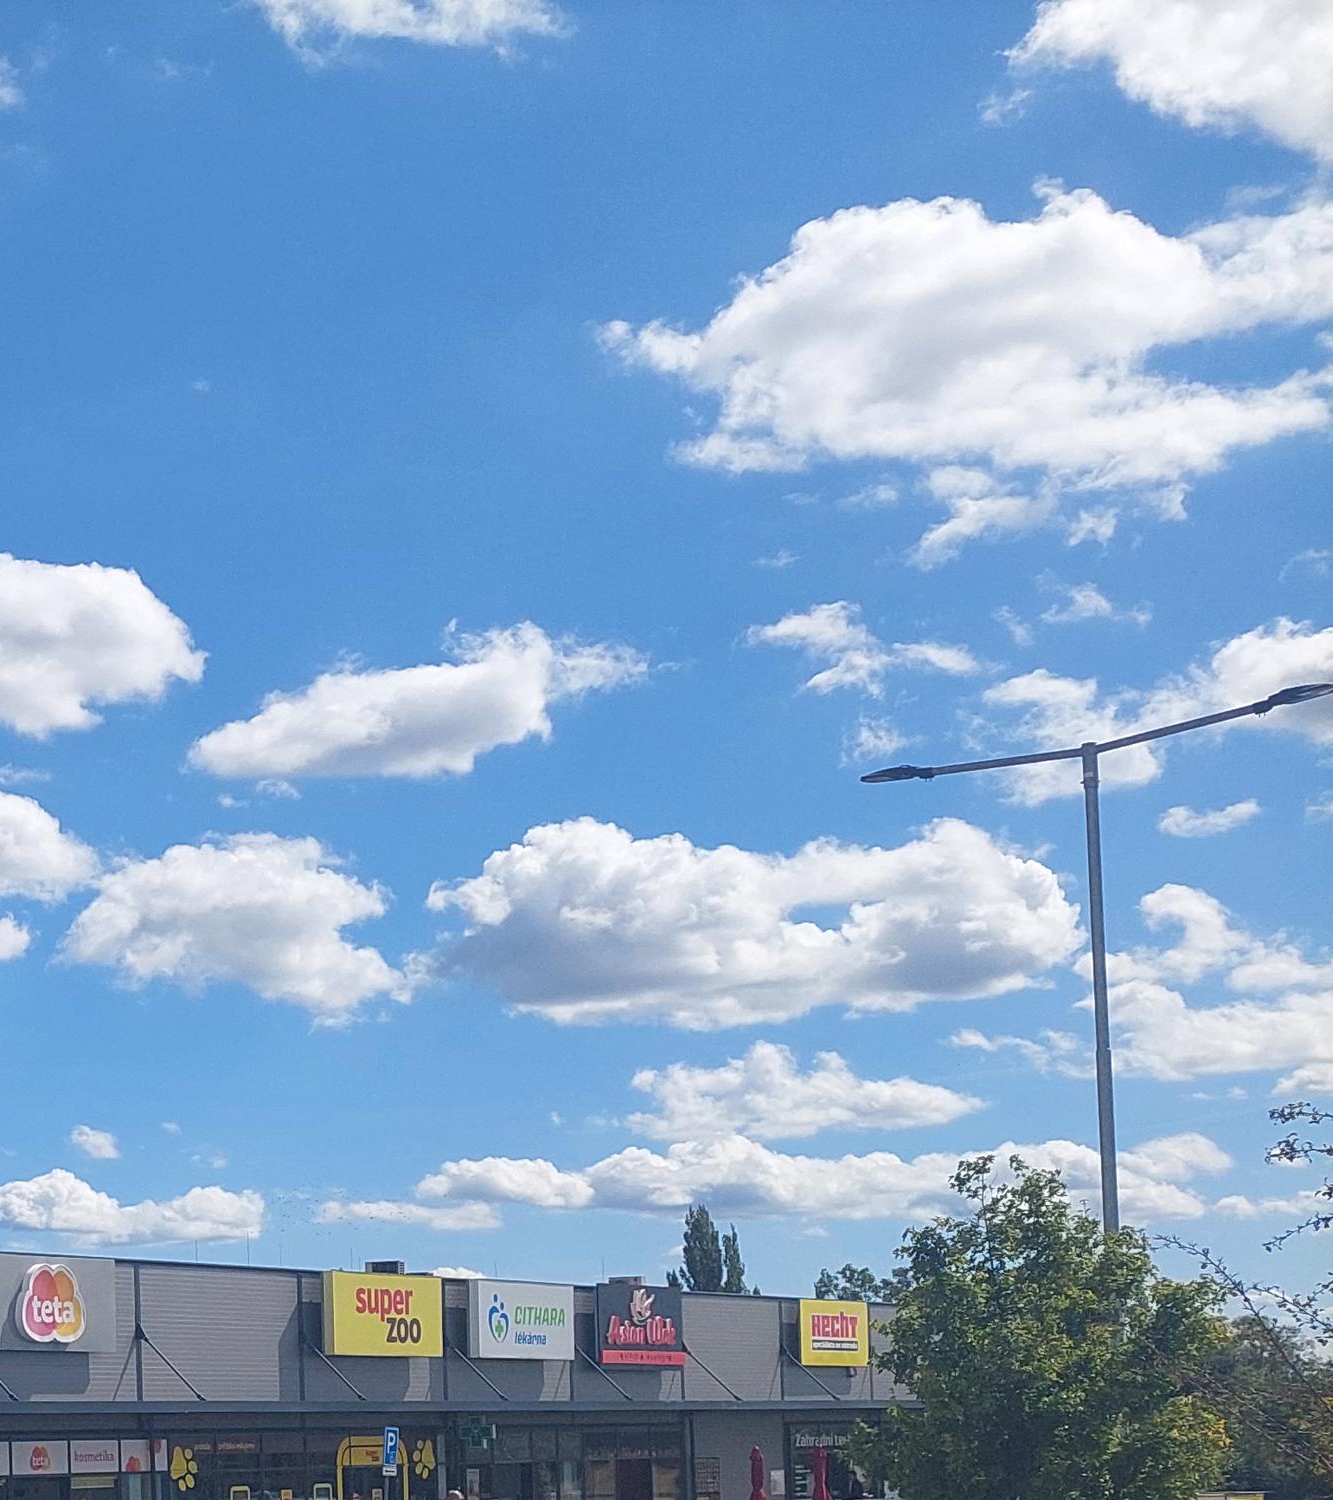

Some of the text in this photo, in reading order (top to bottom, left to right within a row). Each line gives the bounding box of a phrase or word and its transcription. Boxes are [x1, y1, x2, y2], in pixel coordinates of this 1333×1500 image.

[31, 1295, 76, 1324] teta
[355, 1287, 414, 1323] super
[514, 1305, 566, 1328] CITHARA
[514, 1330, 547, 1346] lékárna
[606, 1315, 647, 1346] Asian
[387, 1432, 396, 1454] P
[74, 1450, 115, 1464] kosmetika
